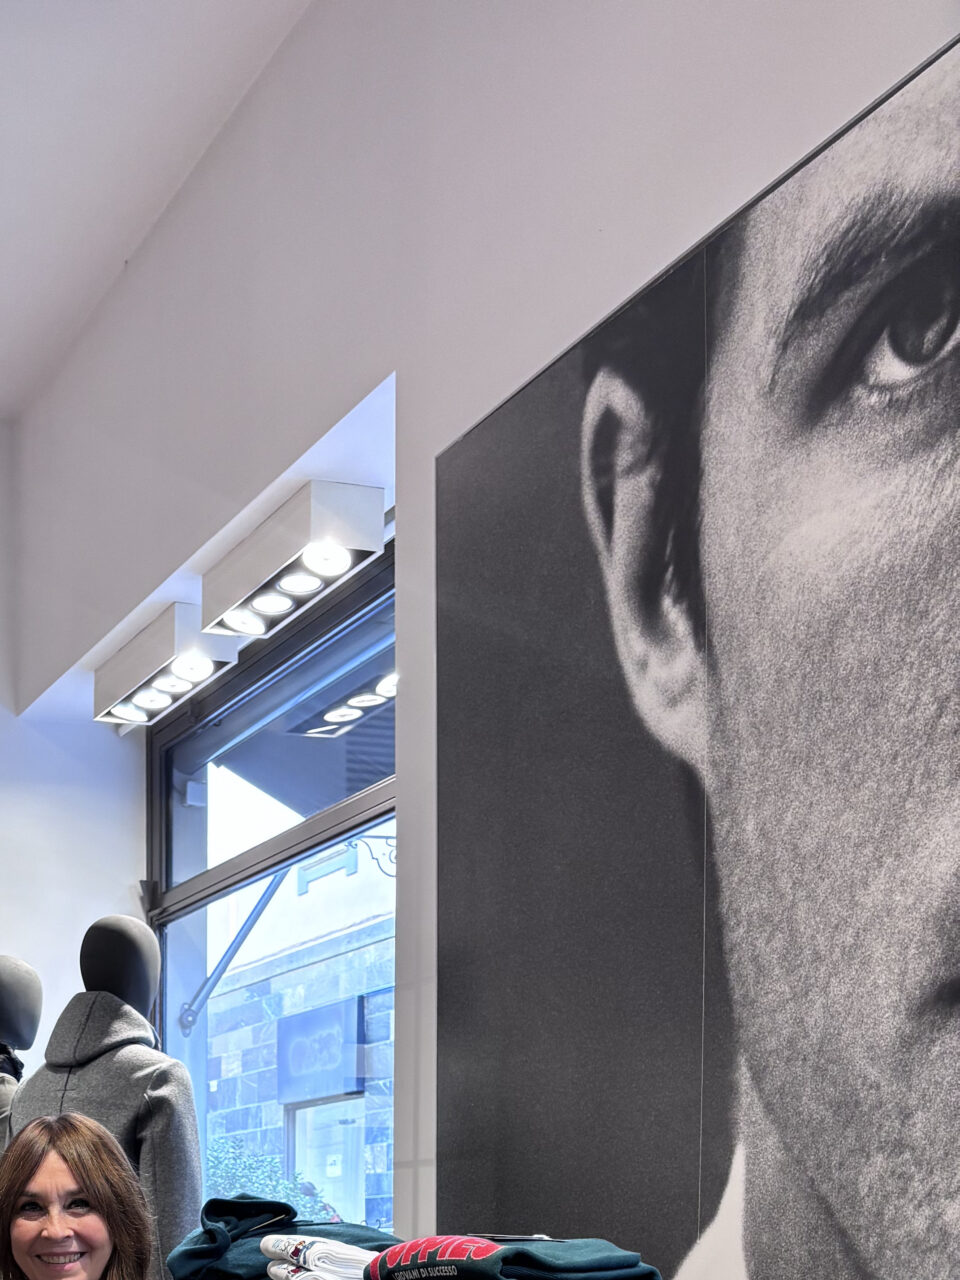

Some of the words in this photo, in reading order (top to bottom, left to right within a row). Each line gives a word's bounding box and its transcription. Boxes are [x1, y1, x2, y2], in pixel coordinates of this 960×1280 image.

[396, 1269, 420, 1280] GIOVANI
[420, 1267, 429, 1278] DI
[429, 1265, 458, 1277] SUCCESSO
